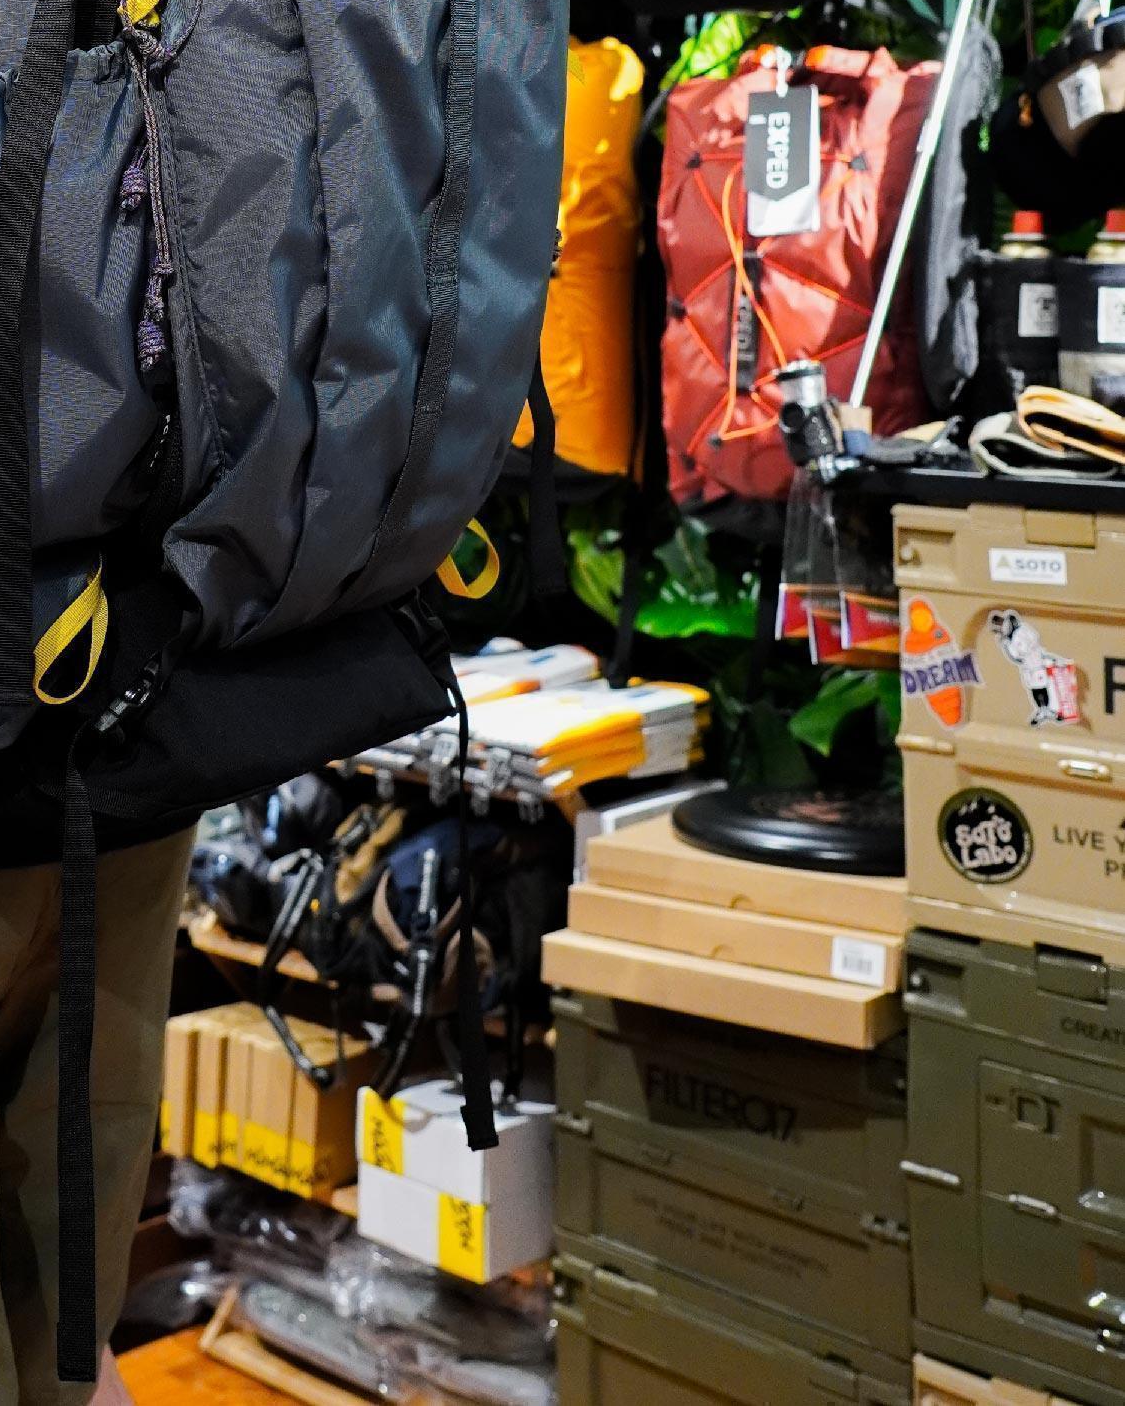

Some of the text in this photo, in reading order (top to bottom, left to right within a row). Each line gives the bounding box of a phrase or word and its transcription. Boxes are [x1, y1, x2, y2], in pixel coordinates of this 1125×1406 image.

[765, 111, 791, 190] EXPED
[1015, 558, 1062, 573] SOTO
[903, 653, 979, 694] DREAM
[1052, 823, 1105, 852] LIVE
